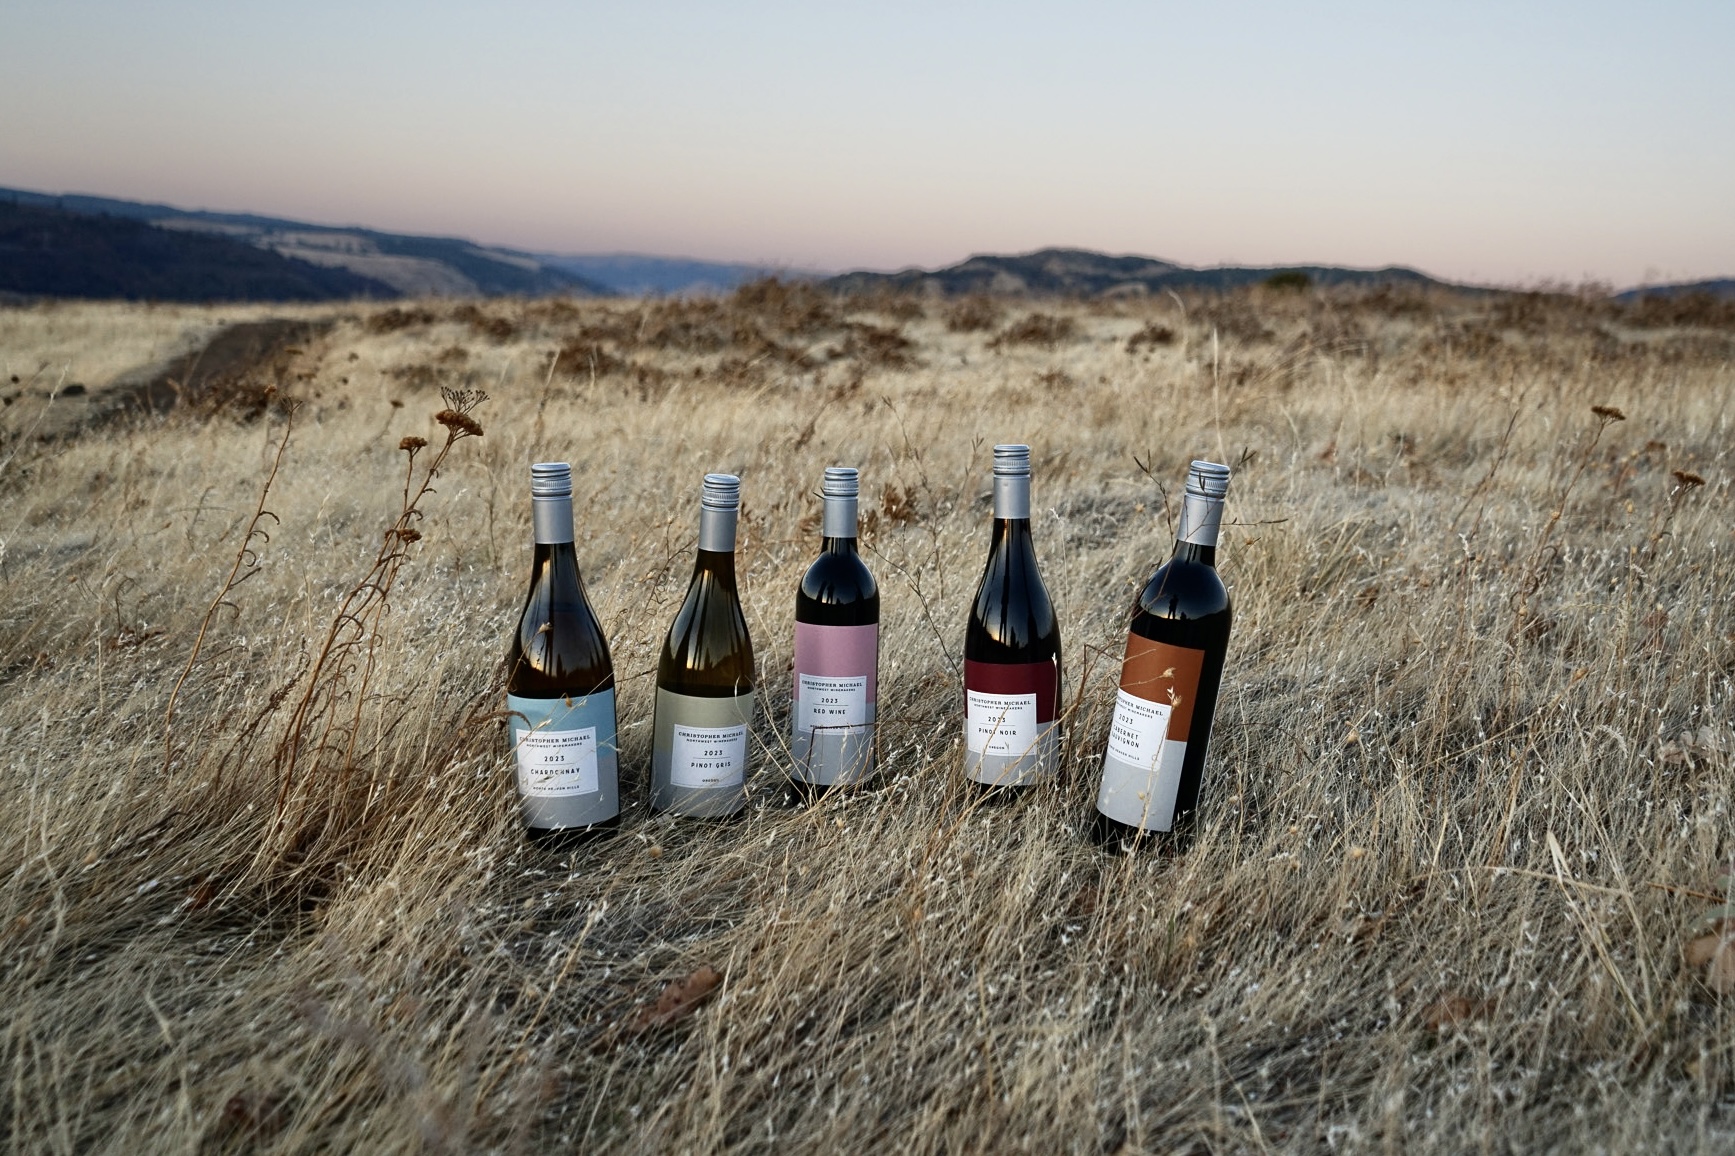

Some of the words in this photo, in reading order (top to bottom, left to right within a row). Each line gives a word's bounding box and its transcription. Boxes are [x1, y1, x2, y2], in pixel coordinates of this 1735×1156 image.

[969, 697, 1001, 705] CHRISTOPHER
[1136, 705, 1163, 716] MICHAEL
[1119, 714, 1133, 724] 2023
[1114, 724, 1138, 739] CABERNET
